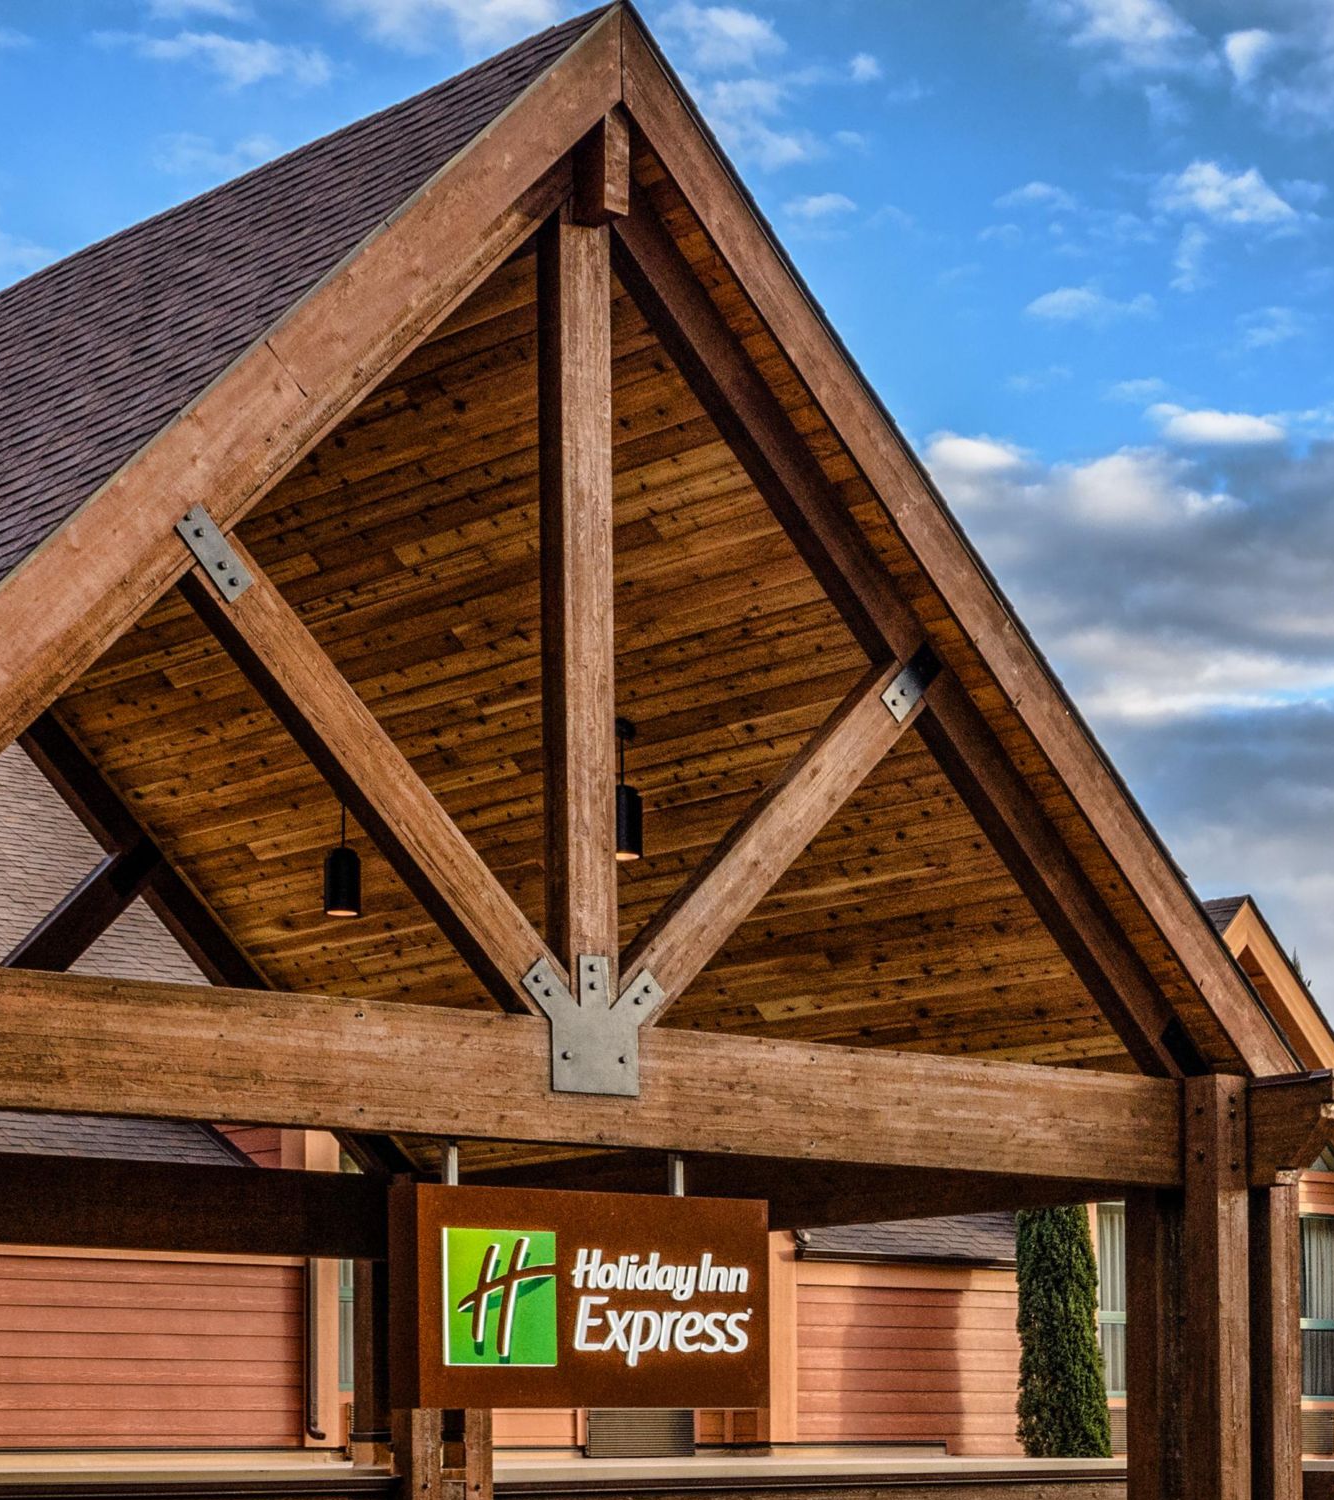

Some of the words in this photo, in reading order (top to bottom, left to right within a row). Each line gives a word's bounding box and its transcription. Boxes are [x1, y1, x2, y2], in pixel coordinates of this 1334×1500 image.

[571, 1248, 697, 1301] Holiday
[698, 1253, 749, 1292] Inn
[574, 1296, 750, 1367] Express
